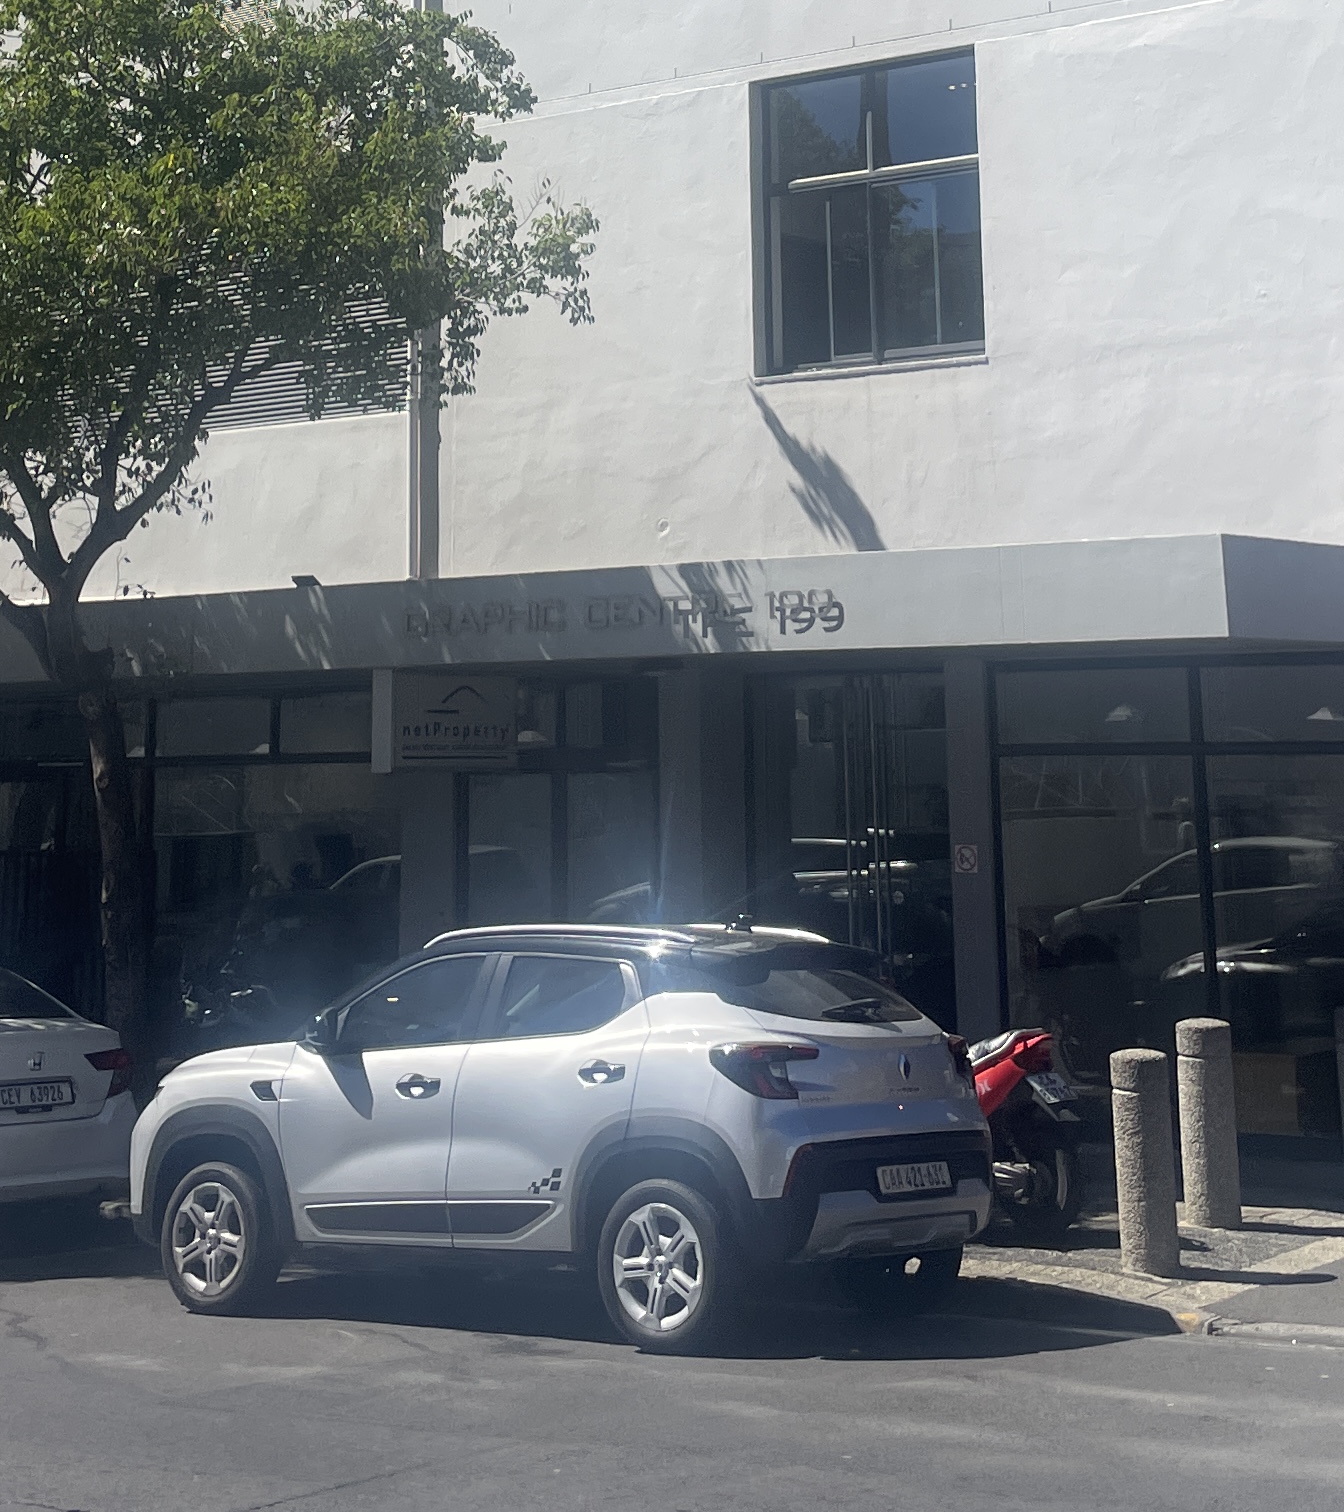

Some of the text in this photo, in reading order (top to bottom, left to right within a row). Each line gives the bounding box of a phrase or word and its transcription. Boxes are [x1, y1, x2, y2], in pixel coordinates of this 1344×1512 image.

[405, 589, 840, 637] GRAPHIC CENTRE 199
